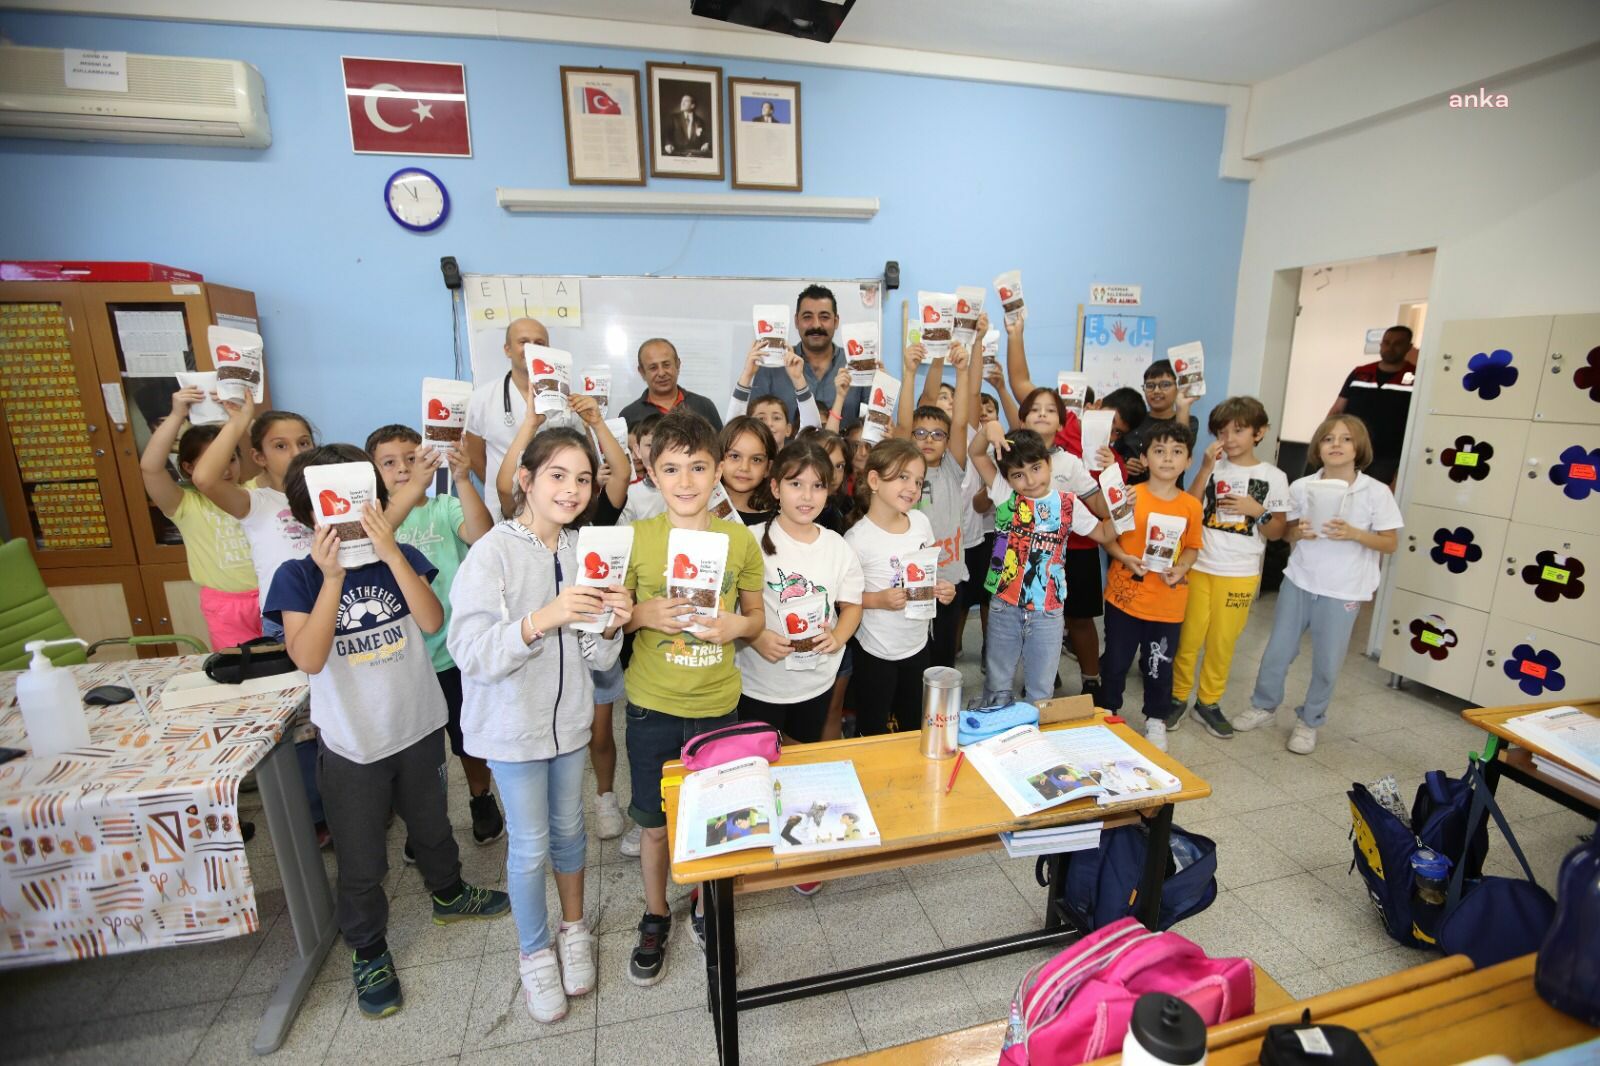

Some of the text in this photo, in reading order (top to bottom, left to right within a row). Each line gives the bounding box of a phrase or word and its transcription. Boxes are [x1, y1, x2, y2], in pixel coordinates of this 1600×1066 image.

[342, 589, 357, 604] OF
[356, 586, 378, 598] THE
[377, 587, 402, 613] FIELD
[336, 633, 384, 656] GAME
[383, 625, 404, 645] ON
[691, 643, 723, 656] TRUE
